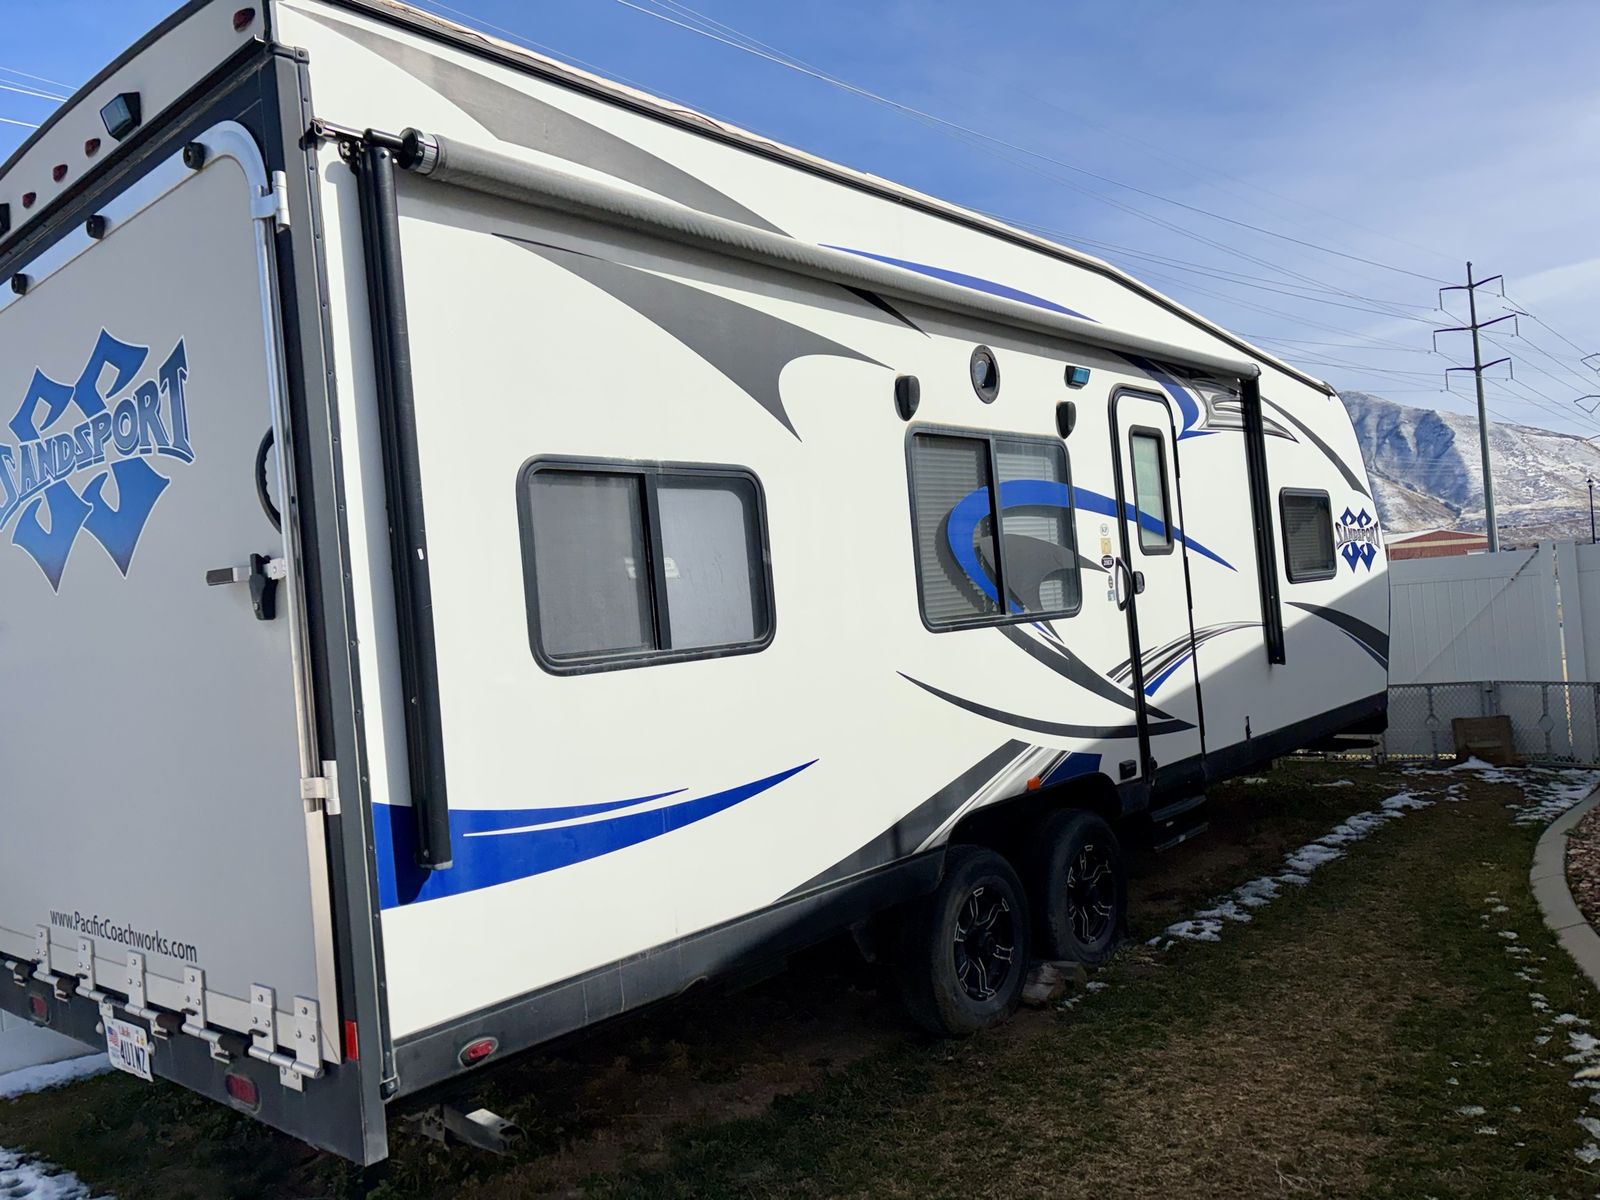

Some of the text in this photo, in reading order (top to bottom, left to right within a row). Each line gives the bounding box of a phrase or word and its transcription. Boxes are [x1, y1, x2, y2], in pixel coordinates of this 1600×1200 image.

[0, 335, 195, 532] SANDSPORT
[1335, 521, 1381, 550] SANDSPORT
[50, 910, 198, 963] www.PacificCoachworks.com
